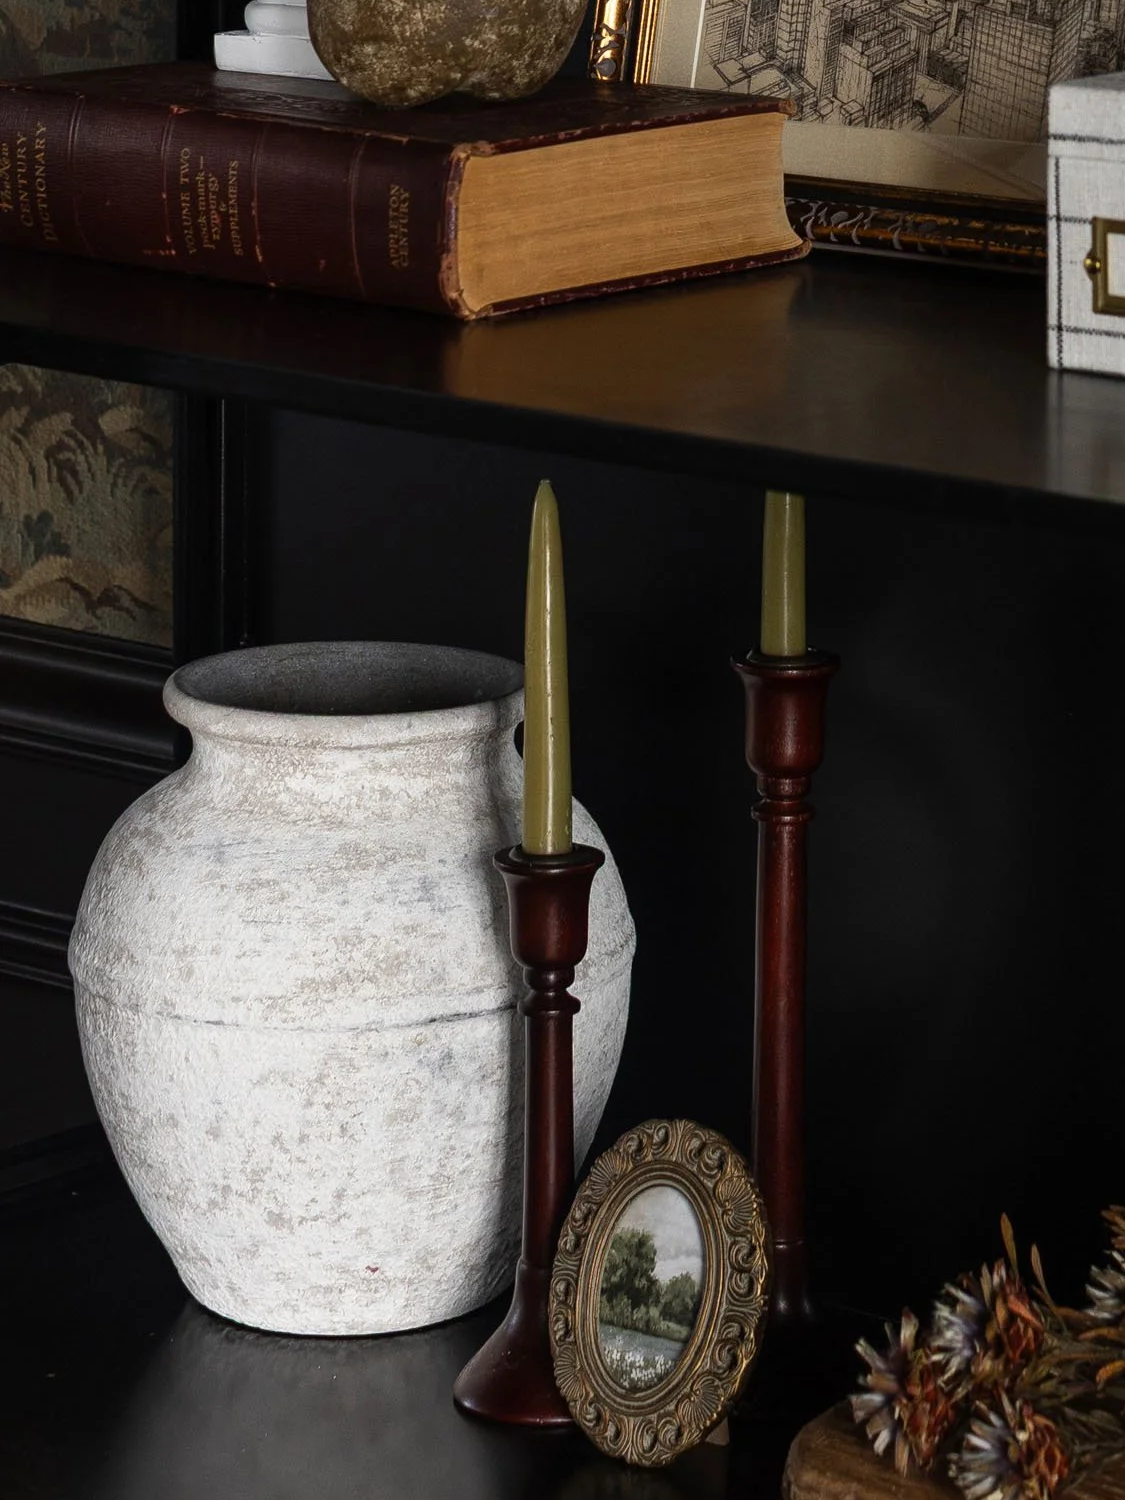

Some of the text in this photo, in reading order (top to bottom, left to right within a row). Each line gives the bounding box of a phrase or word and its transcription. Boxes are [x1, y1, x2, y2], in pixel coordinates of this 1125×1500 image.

[17, 132, 34, 228] CENTURY
[35, 121, 59, 243] DICTIONARY
[180, 148, 197, 256] VOLUME TWO
[229, 160, 244, 256] SUPPLEMENTS
[388, 183, 401, 269] APPLETON
[399, 187, 410, 267] CENTURY
